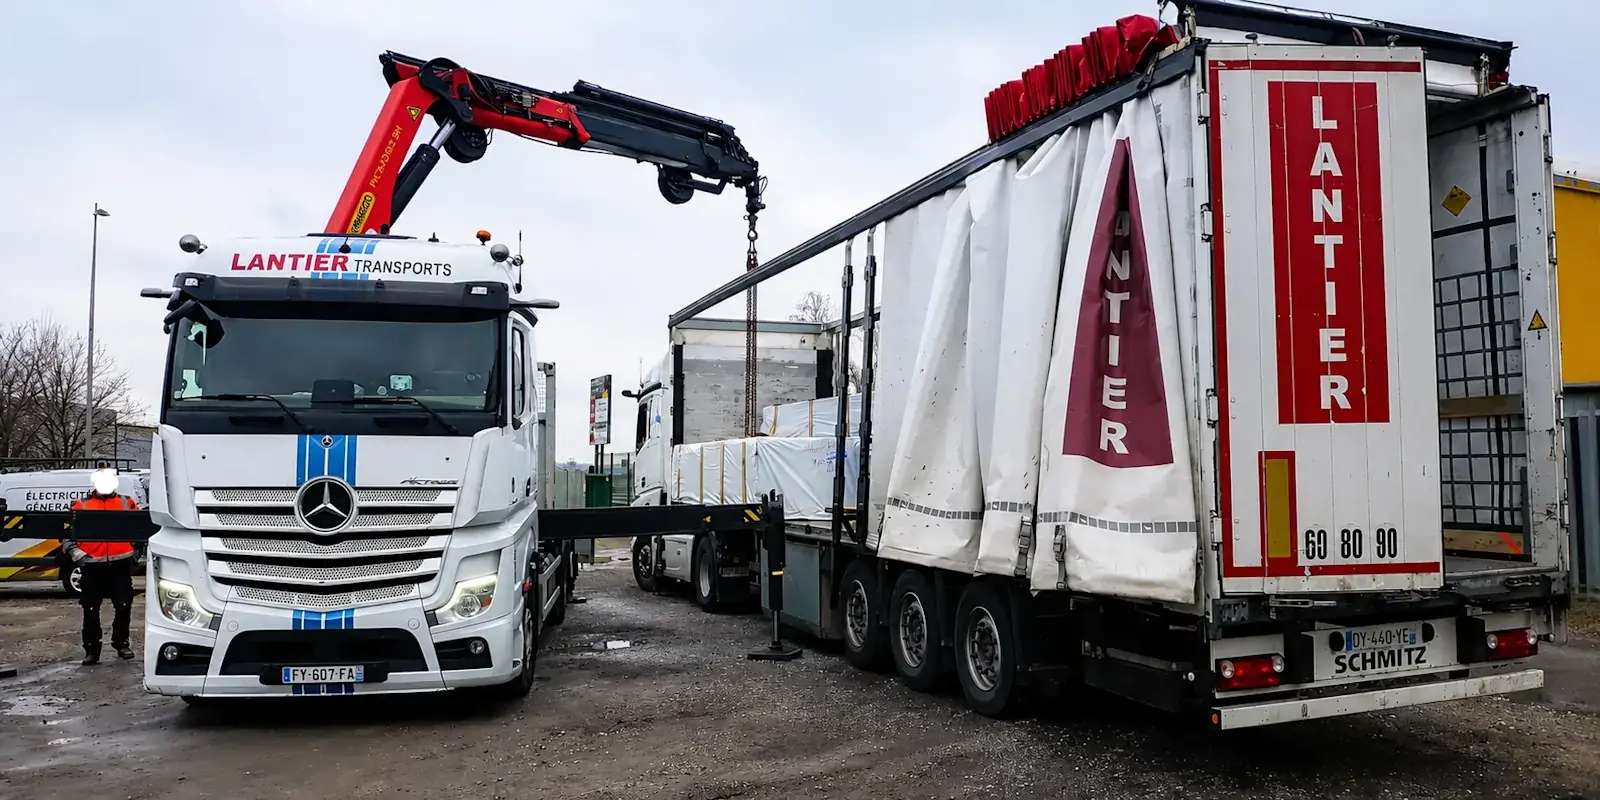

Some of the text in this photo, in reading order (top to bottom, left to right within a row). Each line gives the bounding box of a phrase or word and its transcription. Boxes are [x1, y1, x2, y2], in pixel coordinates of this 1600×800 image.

[231, 253, 452, 277] LANTIER TRANSPORTS
[1310, 95, 1352, 410] LANTIER
[1100, 210, 1130, 454] ANTIER
[1305, 528, 1397, 559] 60 80 90
[1334, 645, 1427, 674] SCHMITZ
